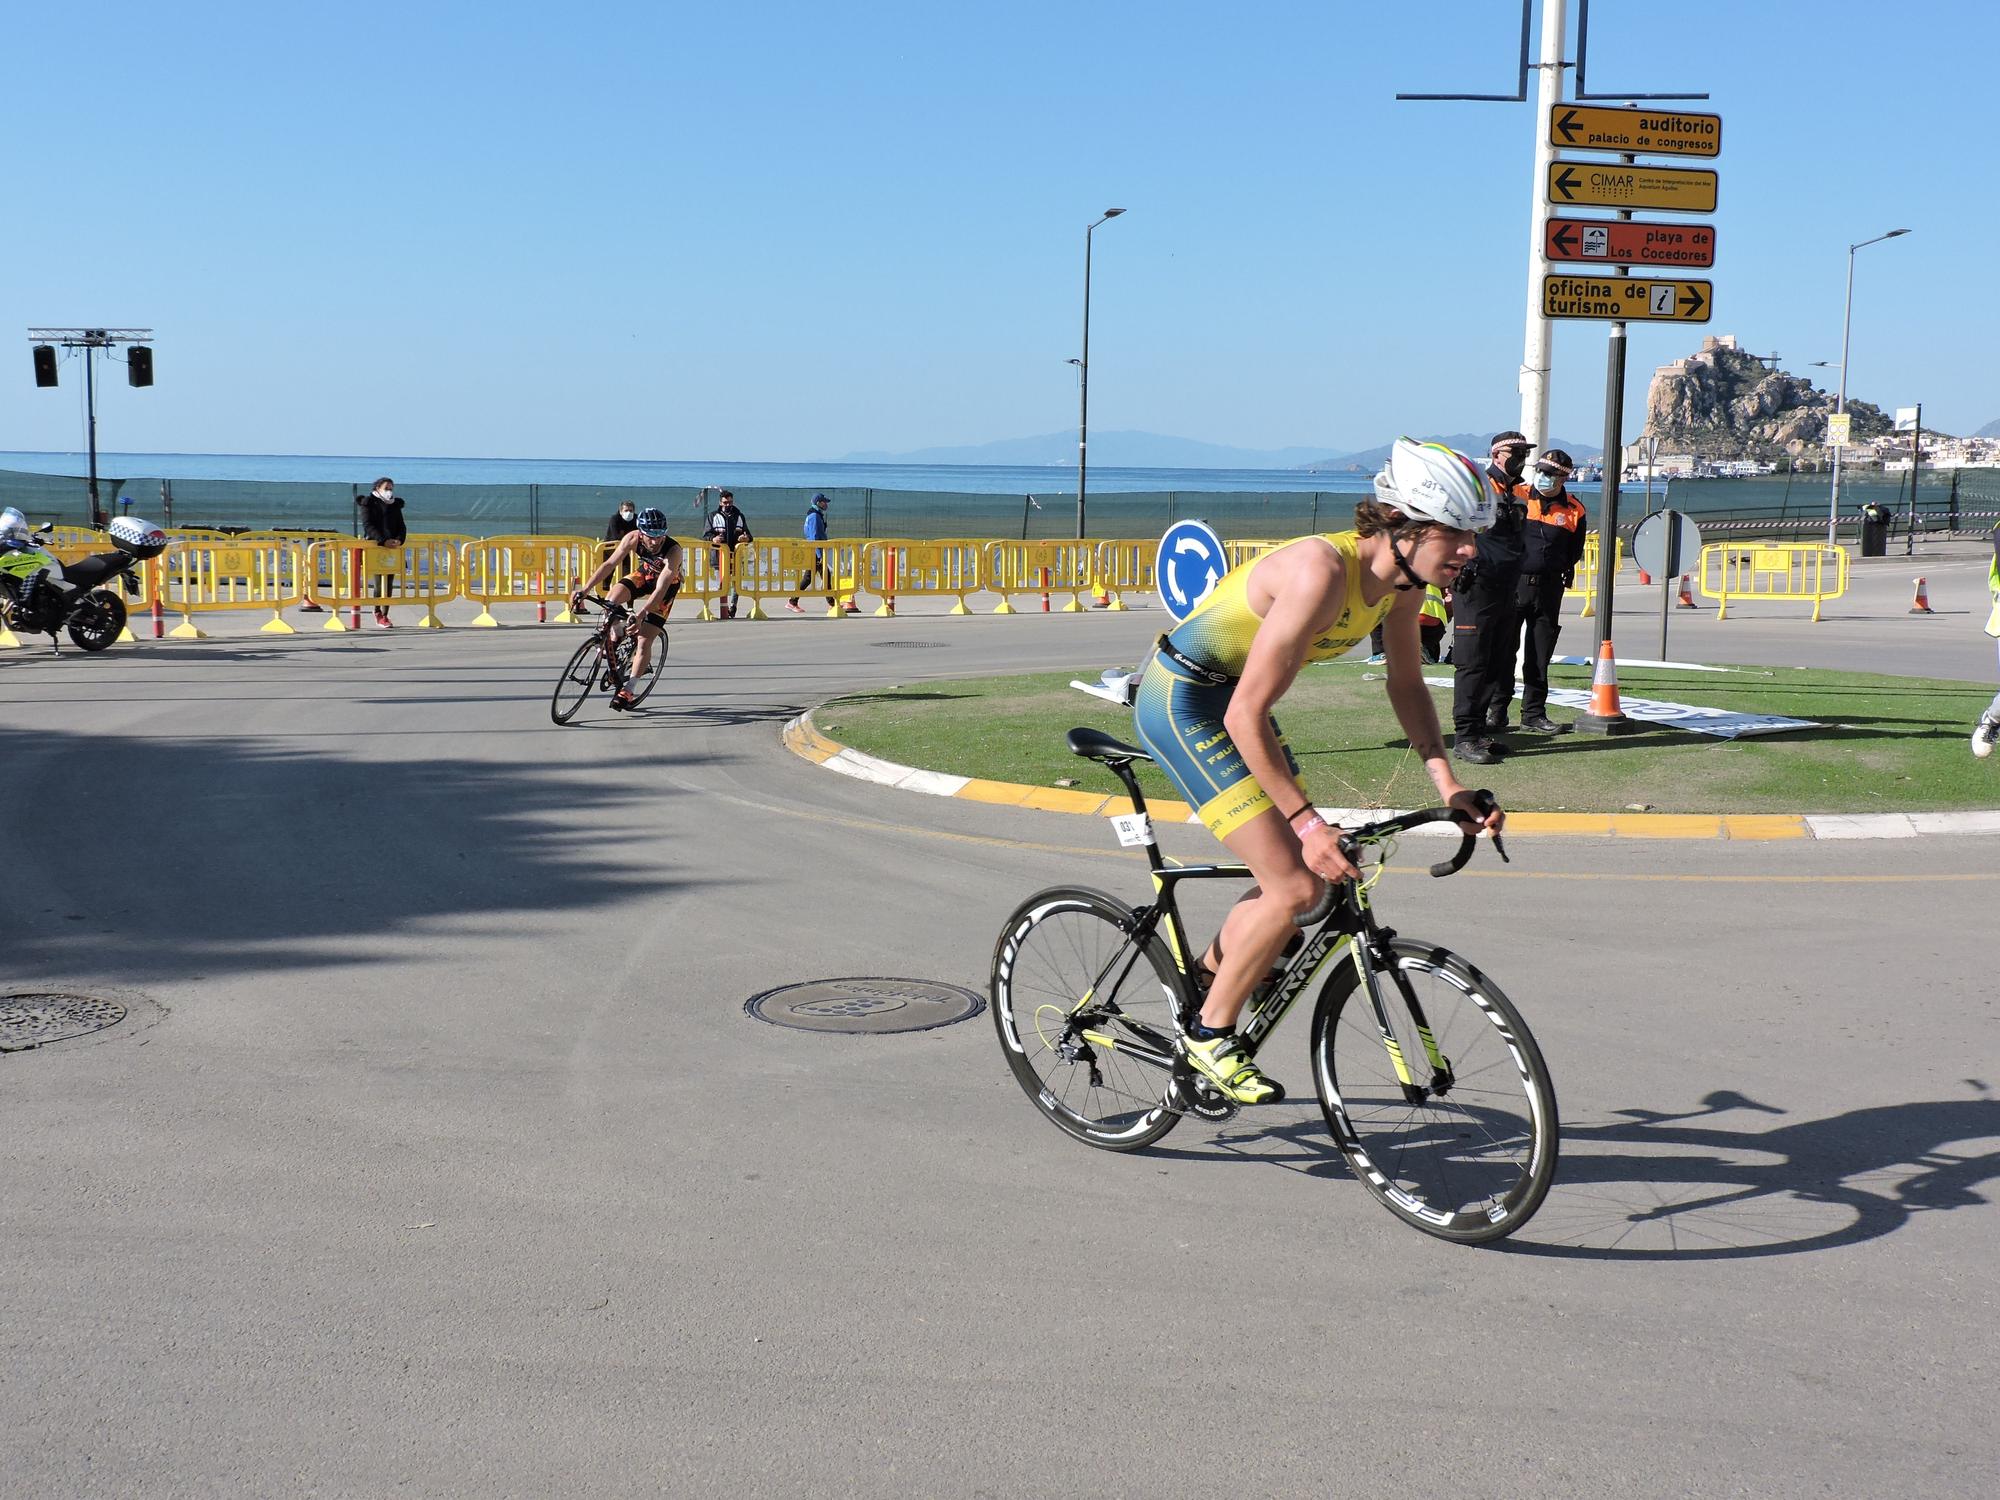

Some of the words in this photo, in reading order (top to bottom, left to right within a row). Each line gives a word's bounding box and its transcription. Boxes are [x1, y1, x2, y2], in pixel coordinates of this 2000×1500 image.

[1640, 117, 1714, 134] auditorio
[1588, 132, 1630, 144] palacio
[1636, 135, 1650, 146] de
[1657, 138, 1713, 150] congresos
[1590, 173, 1634, 188] CIMAR
[1646, 230, 1683, 245] playa
[1692, 232, 1709, 244] de
[1611, 246, 1633, 258] Los
[1641, 247, 1708, 261] Cocedores
[1549, 280, 1612, 298] oficina
[1624, 283, 1647, 298] de
[1549, 296, 1621, 314] turismo
[1194, 1104, 1229, 1117] ROTOR
